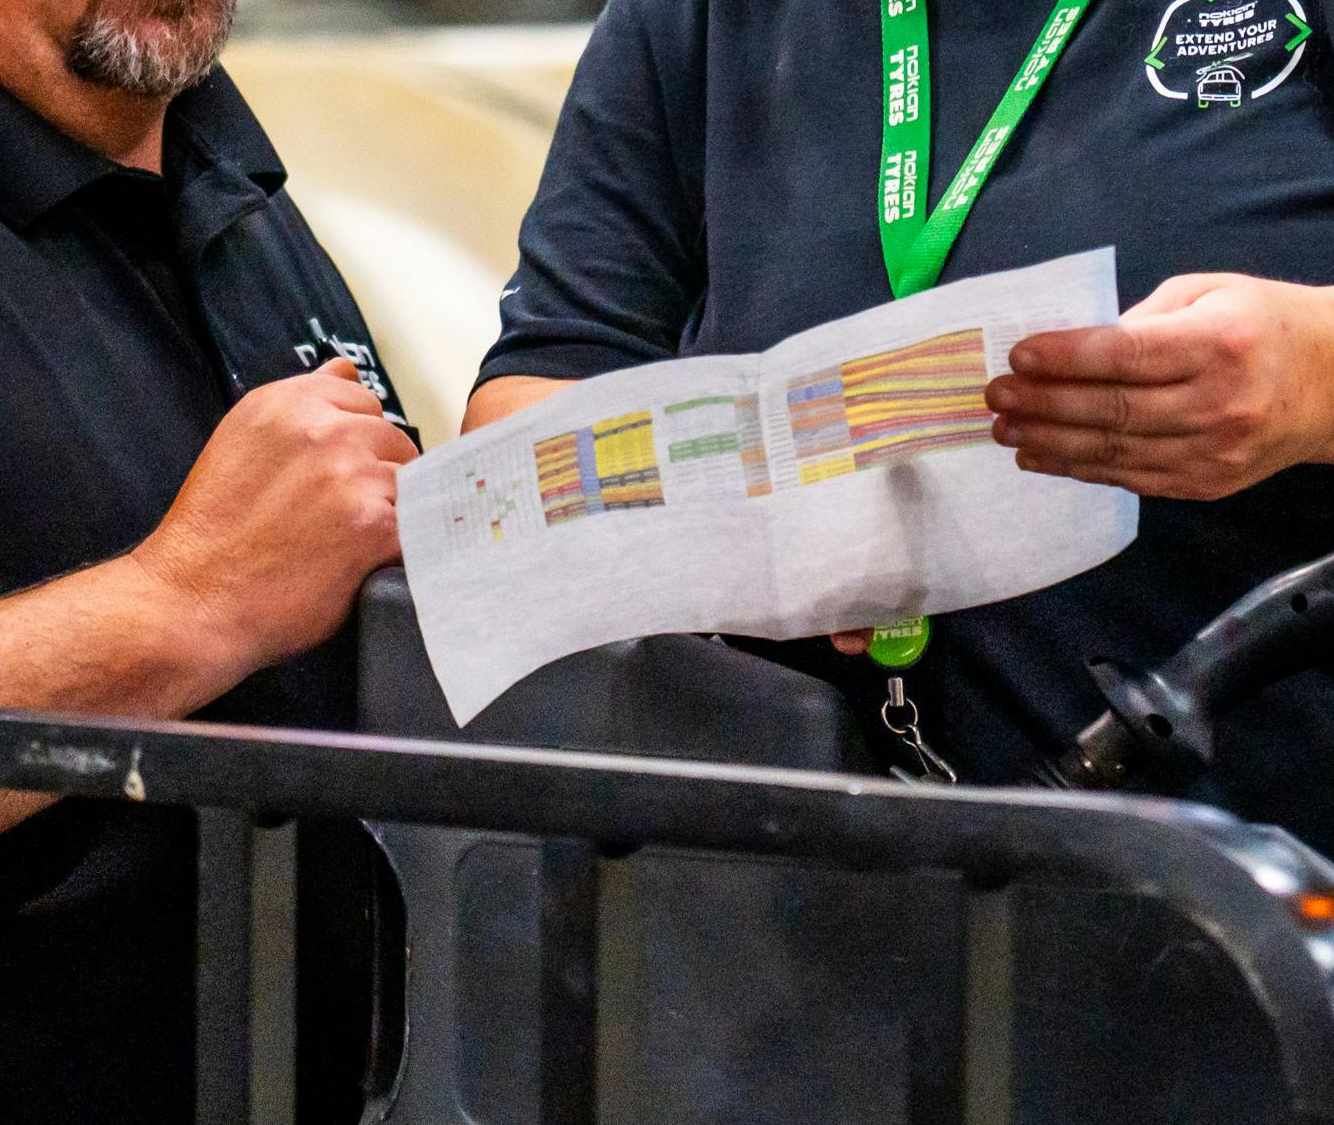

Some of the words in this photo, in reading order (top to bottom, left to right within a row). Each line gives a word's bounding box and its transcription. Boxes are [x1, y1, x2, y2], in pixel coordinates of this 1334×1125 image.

[1175, 31, 1235, 45] EXTEND
[1238, 19, 1277, 38] YOUR
[1177, 31, 1274, 57] ADVENTURES
[1199, 9, 1255, 27] TYRES
[889, 49, 905, 127] TYRES
[907, 44, 920, 123] nokian
[884, 152, 902, 224] TYRES
[902, 150, 917, 219] nokian
